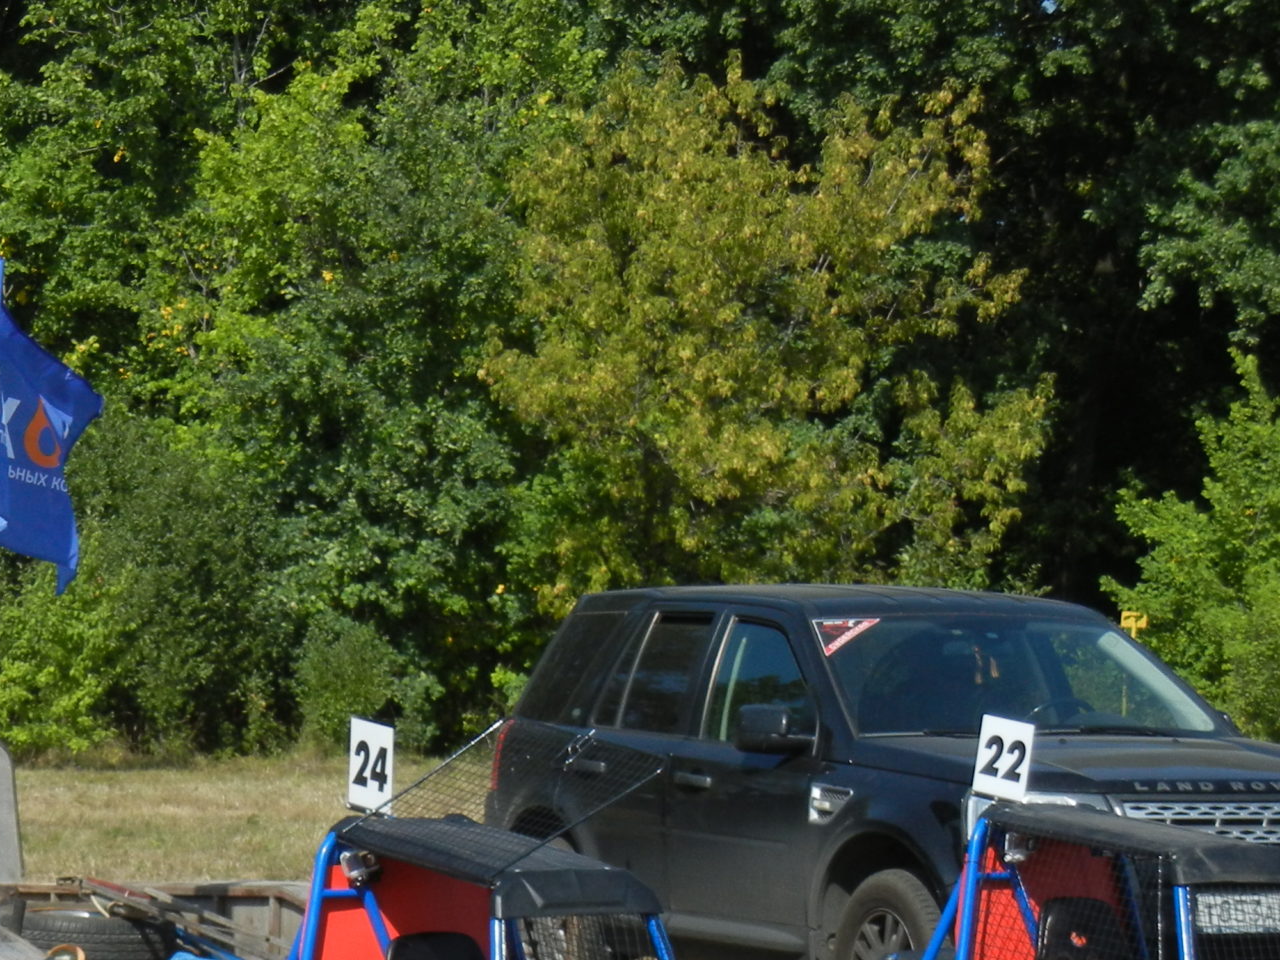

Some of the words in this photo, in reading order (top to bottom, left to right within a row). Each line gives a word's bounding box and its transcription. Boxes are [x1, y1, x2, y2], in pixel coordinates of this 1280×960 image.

[352, 740, 388, 792] 24
[979, 735, 1026, 783] 22
[1133, 781, 1215, 792] LAND
